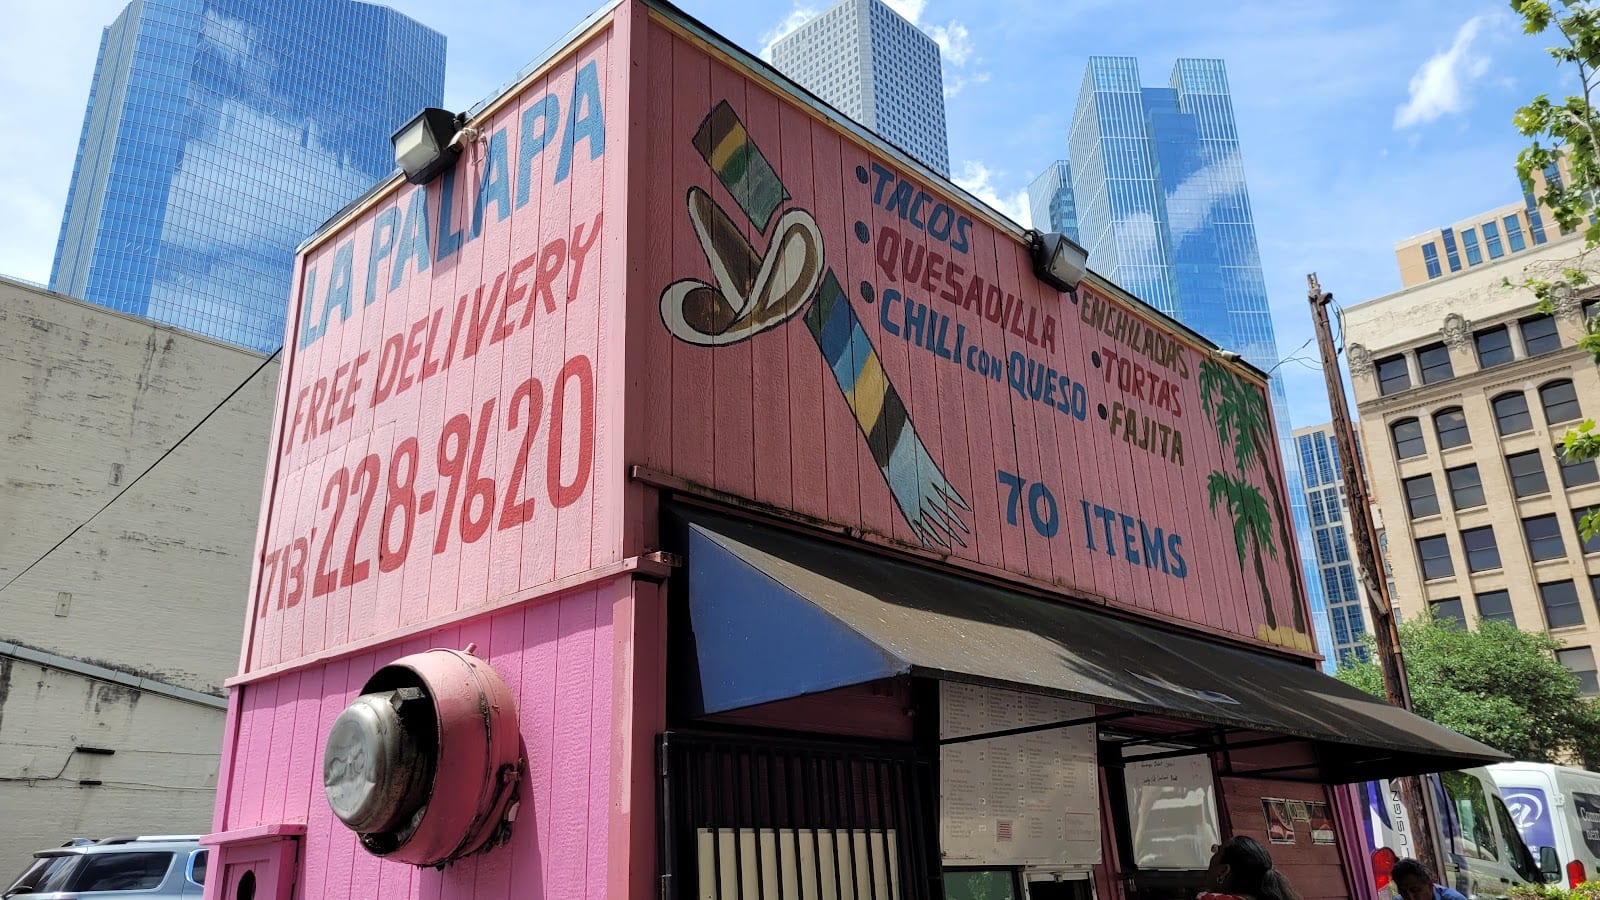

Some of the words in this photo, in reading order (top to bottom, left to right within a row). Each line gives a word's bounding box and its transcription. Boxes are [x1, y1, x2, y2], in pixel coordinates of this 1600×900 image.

[299, 238, 353, 351] LA
[365, 60, 605, 308] PALAPA
[871, 162, 972, 253] TACOS
[285, 350, 371, 455] FREE
[369, 212, 603, 408] DELIVERY
[876, 226, 1056, 354] QUESADILLA
[1080, 290, 1189, 380] ENCHILADAS
[880, 288, 965, 364] CHILI
[1009, 351, 1087, 421] QUESO
[1101, 346, 1182, 418] TORTAS
[312, 354, 594, 598] 228-9620
[1110, 402, 1184, 466] FAJITA
[998, 469, 1059, 538] 70
[1080, 500, 1187, 578] ITEMS
